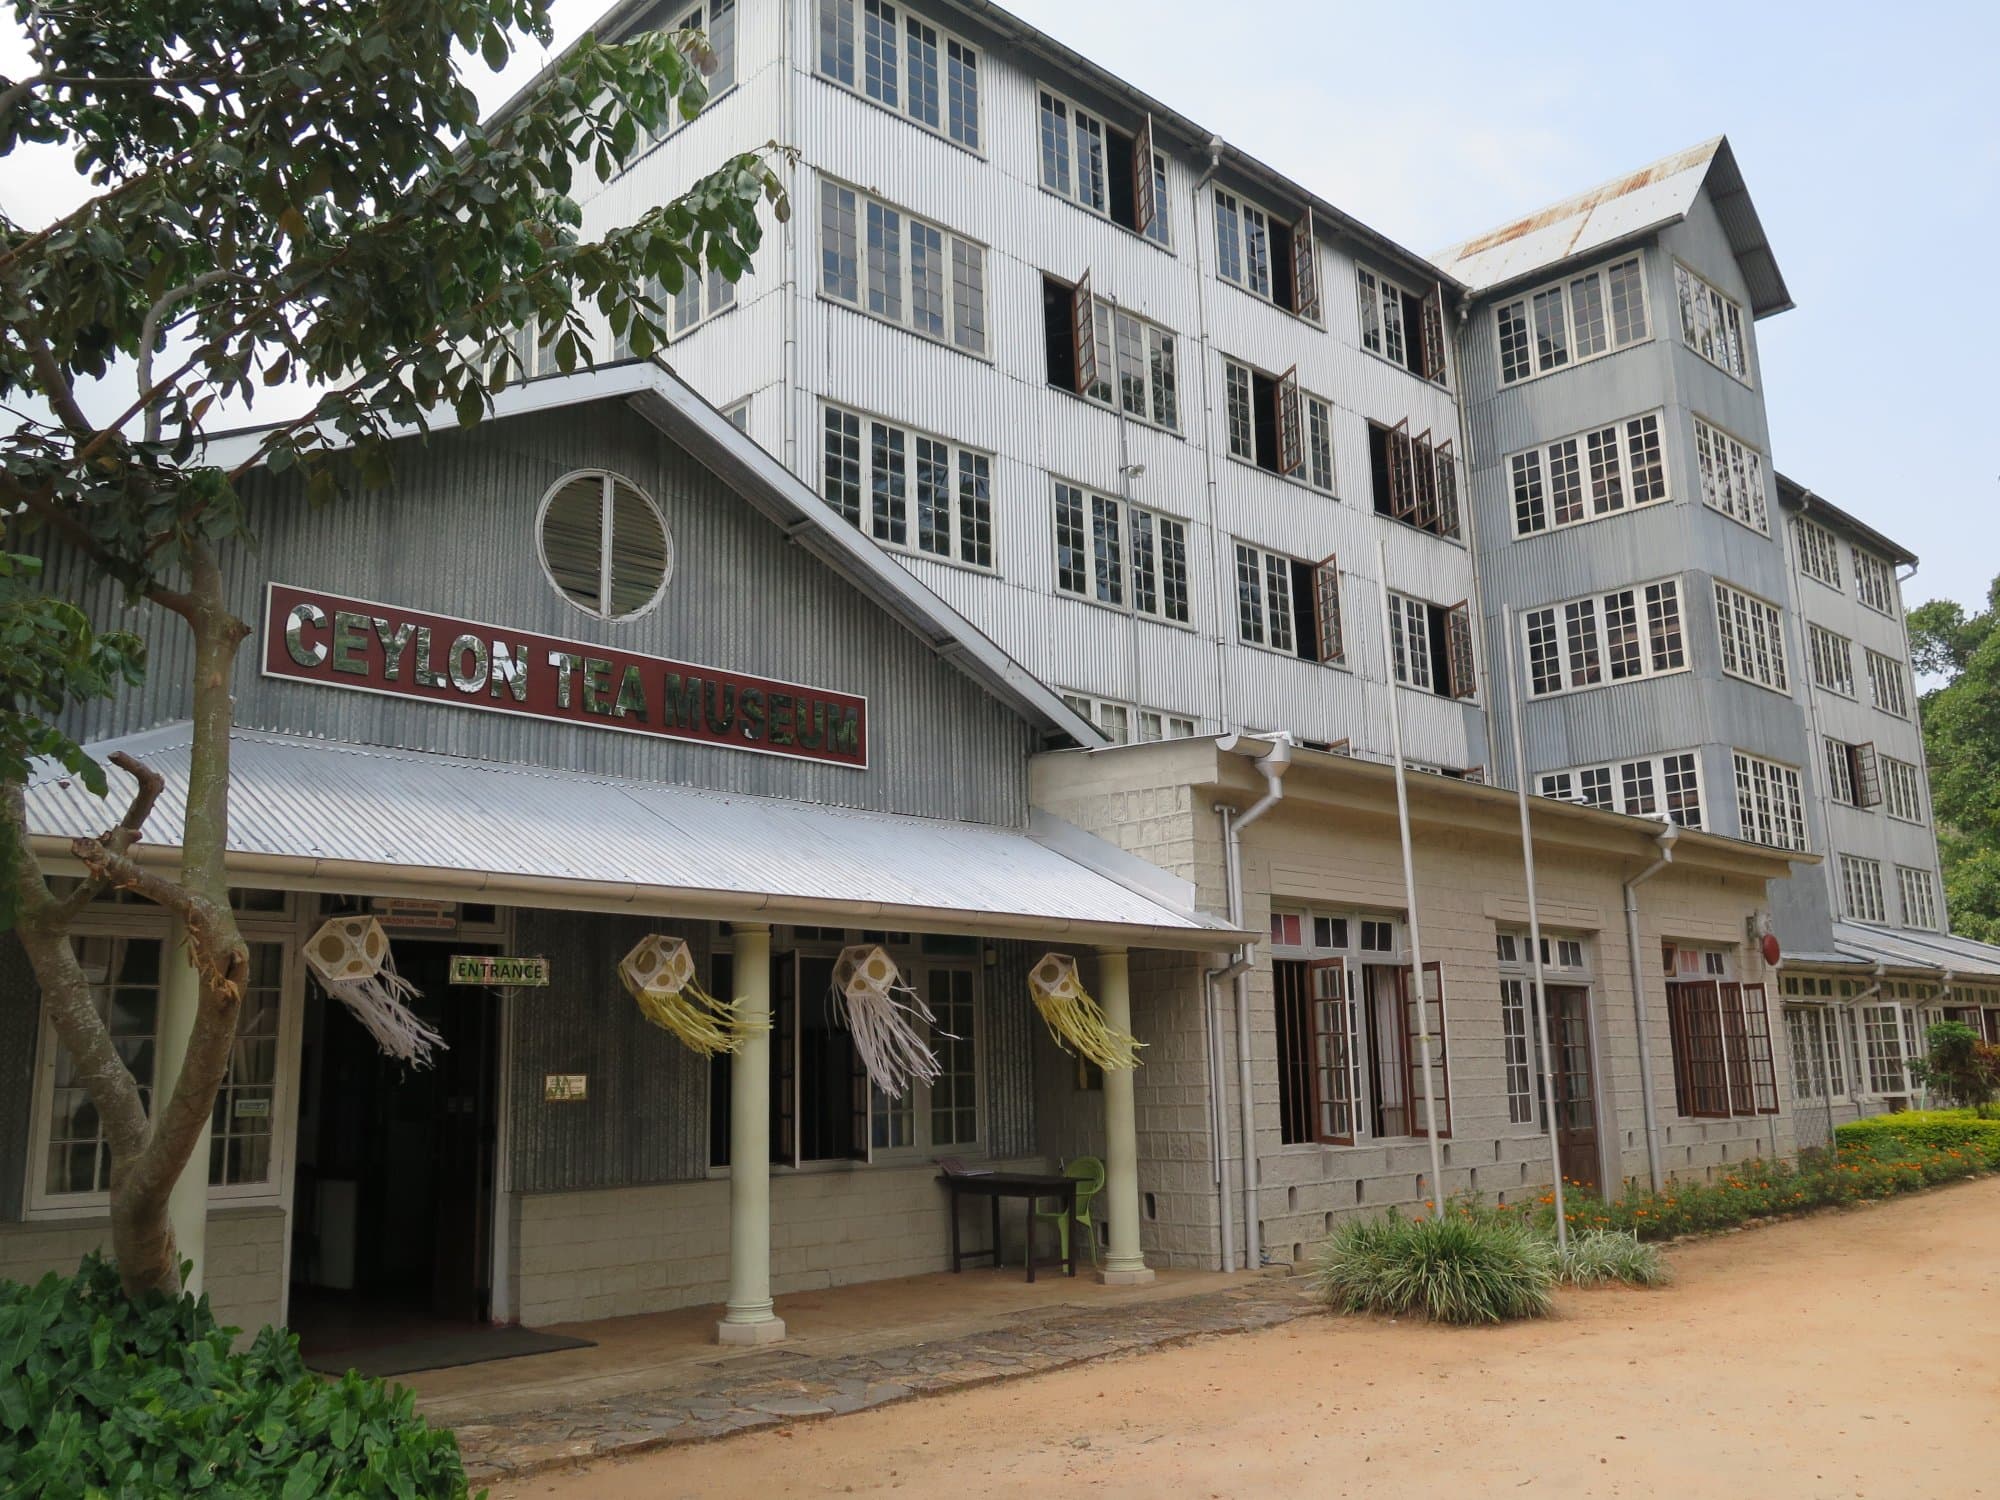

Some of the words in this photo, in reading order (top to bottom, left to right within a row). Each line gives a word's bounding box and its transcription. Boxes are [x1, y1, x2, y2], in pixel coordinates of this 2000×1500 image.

[285, 603, 528, 701] CEYLON
[548, 651, 648, 721] TEA
[663, 673, 858, 755] MUSEUM
[457, 962, 543, 979] ENTRANCE
